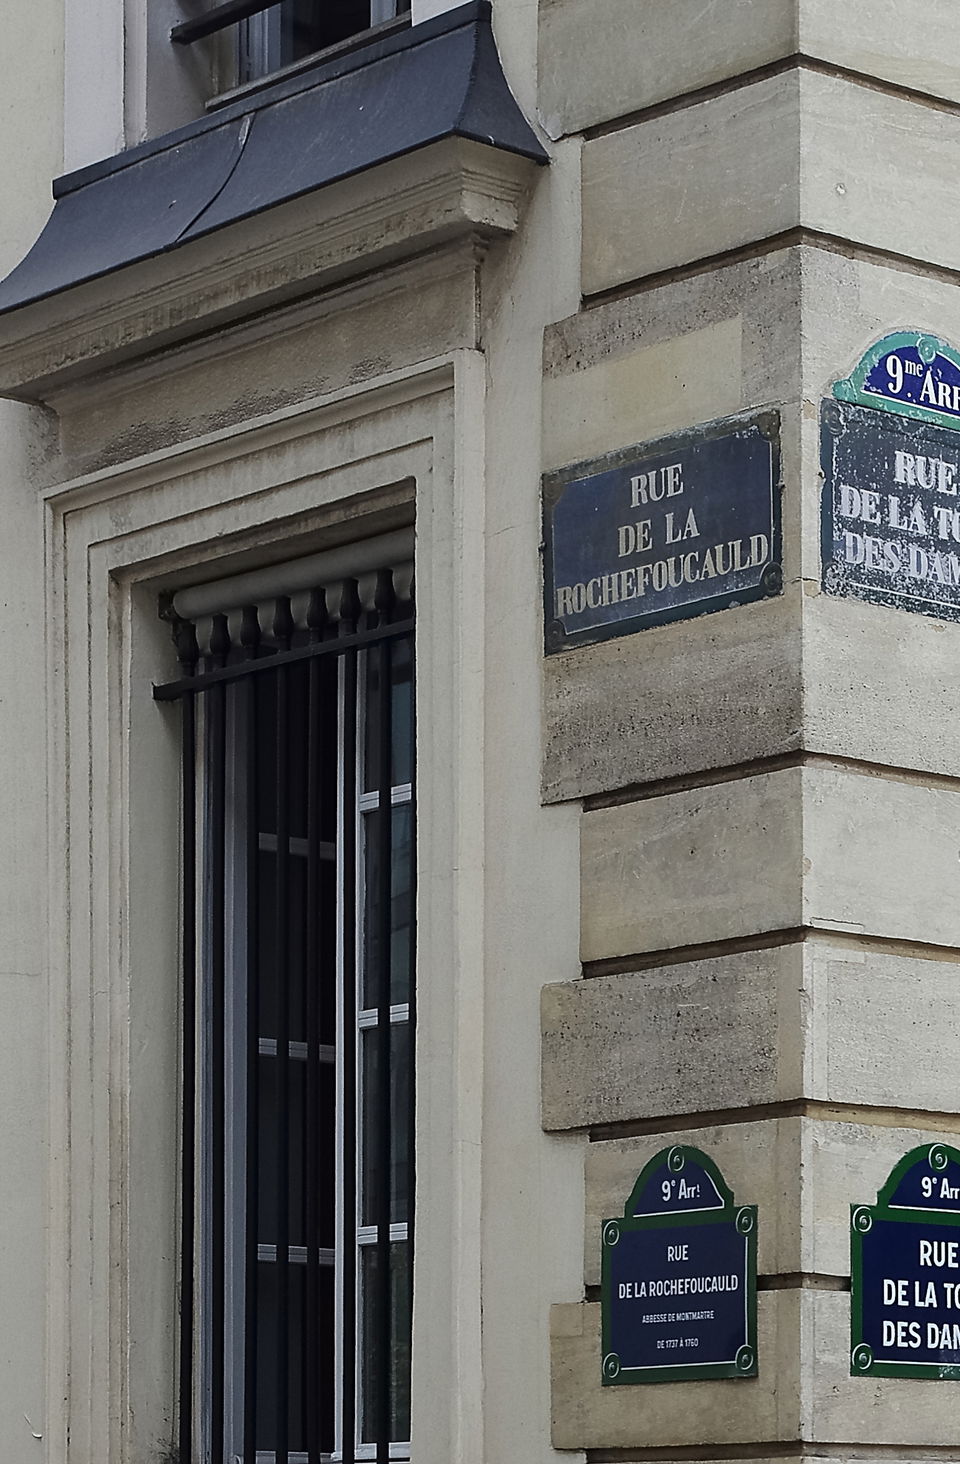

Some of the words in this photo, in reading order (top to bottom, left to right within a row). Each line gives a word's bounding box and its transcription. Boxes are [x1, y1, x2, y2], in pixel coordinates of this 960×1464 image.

[630, 463, 683, 508] RUE
[893, 450, 957, 496] RUE
[839, 484, 881, 525] DE
[887, 494, 928, 535] LA
[617, 519, 652, 557] DE
[665, 507, 700, 545] LA
[843, 530, 902, 574] DES
[555, 533, 769, 619] ROCHEFOUCAULD
[667, 1244, 689, 1262] RUE
[919, 1239, 959, 1268] RUE
[618, 1283, 633, 1299] DE
[634, 1281, 647, 1298] LA
[648, 1274, 739, 1297] ROCHEFOUCAULD
[883, 1279, 909, 1307] DE
[914, 1280, 938, 1308] LA
[641, 1313, 667, 1324] ABBESSE
[667, 1312, 676, 1322] DE
[676, 1310, 715, 1321] MONTMARTRE
[656, 1340, 665, 1349] DE
[665, 1339, 679, 1349] 1737
[882, 1320, 922, 1349] DES
